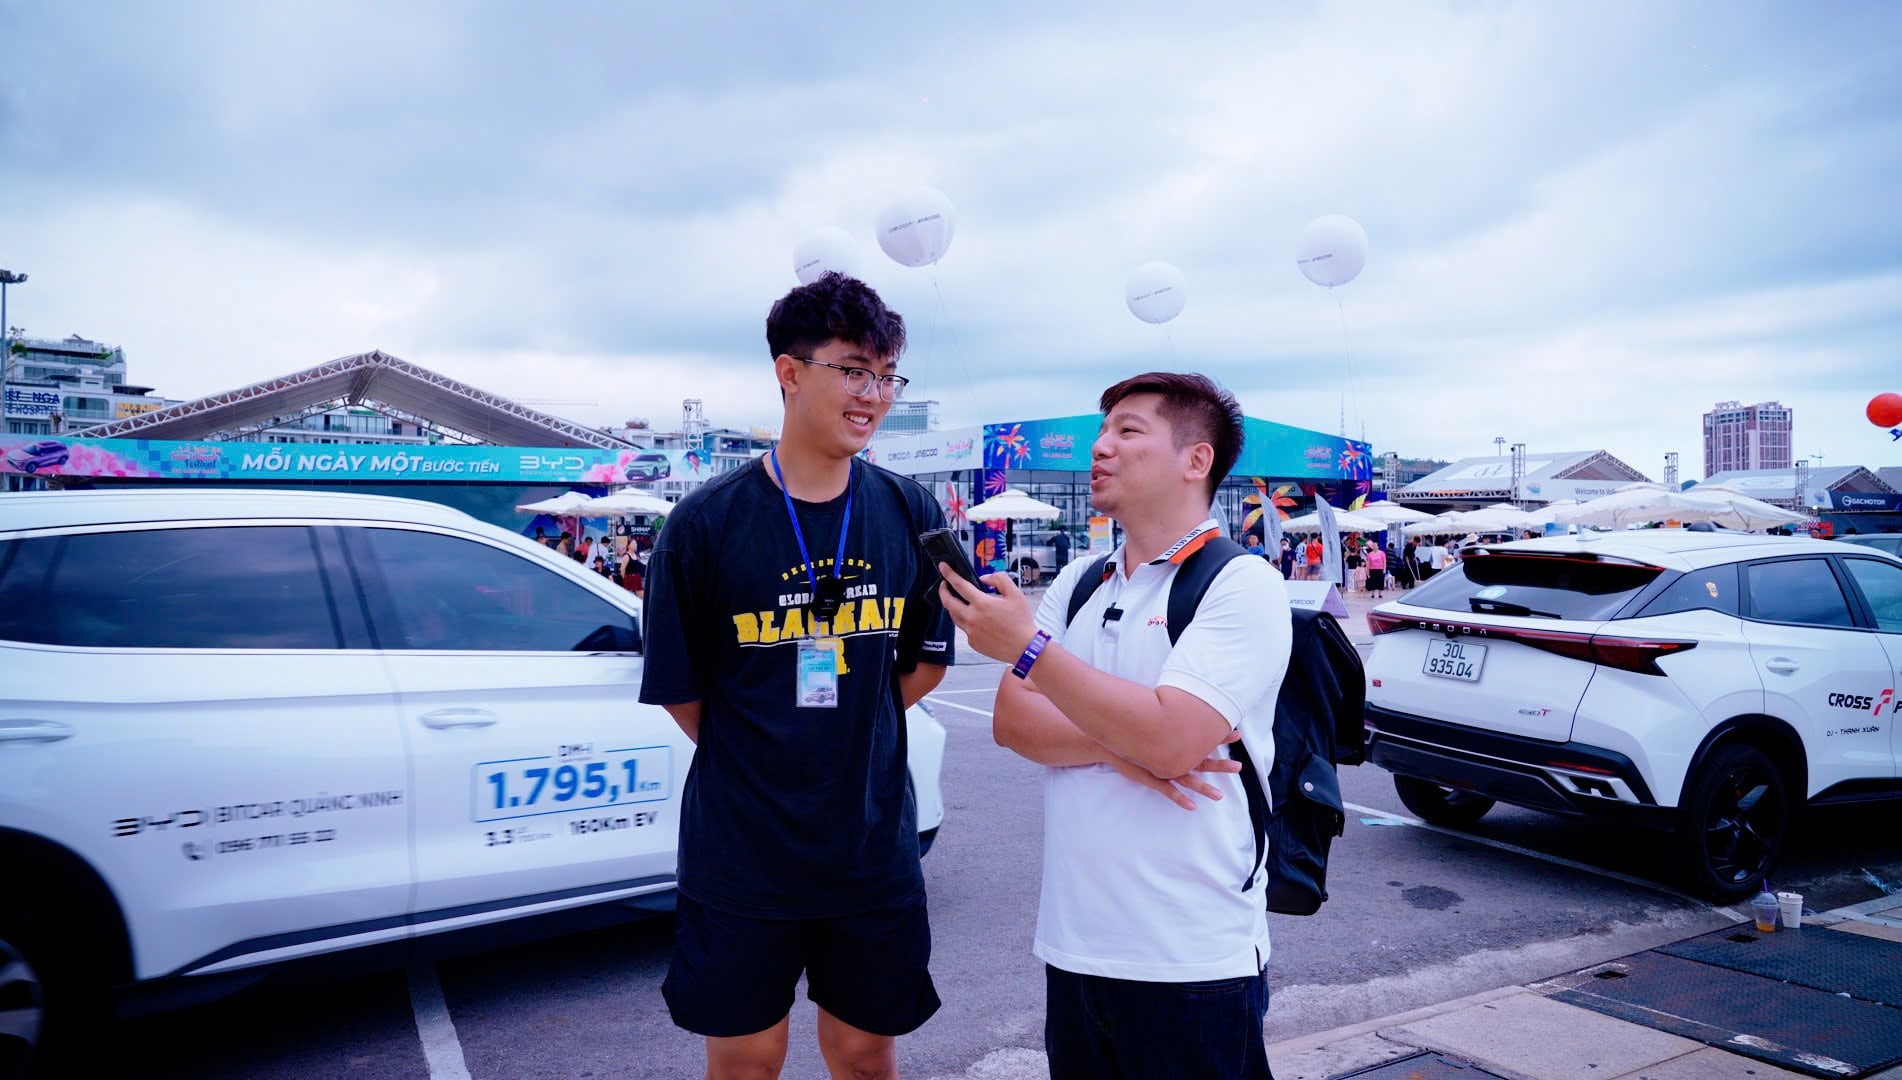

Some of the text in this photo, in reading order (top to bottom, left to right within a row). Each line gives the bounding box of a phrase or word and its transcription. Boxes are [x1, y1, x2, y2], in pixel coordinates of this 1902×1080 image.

[241, 447, 292, 471] MỖI
[297, 451, 367, 472] NGÀY
[370, 452, 424, 476] MỘT
[422, 459, 465, 473] BƯỚC
[468, 459, 500, 474] TIẾN
[520, 455, 585, 470] BYD
[1575, 488, 1599, 496] Welcome
[779, 583, 878, 607] GLOB READ
[1442, 643, 1466, 660] 30L
[1429, 658, 1474, 679] 935.04
[1828, 692, 1874, 711] CROSS
[1840, 727, 1860, 736] THANH
[488, 759, 639, 810] 1.795,1
[111, 809, 209, 838] BYD
